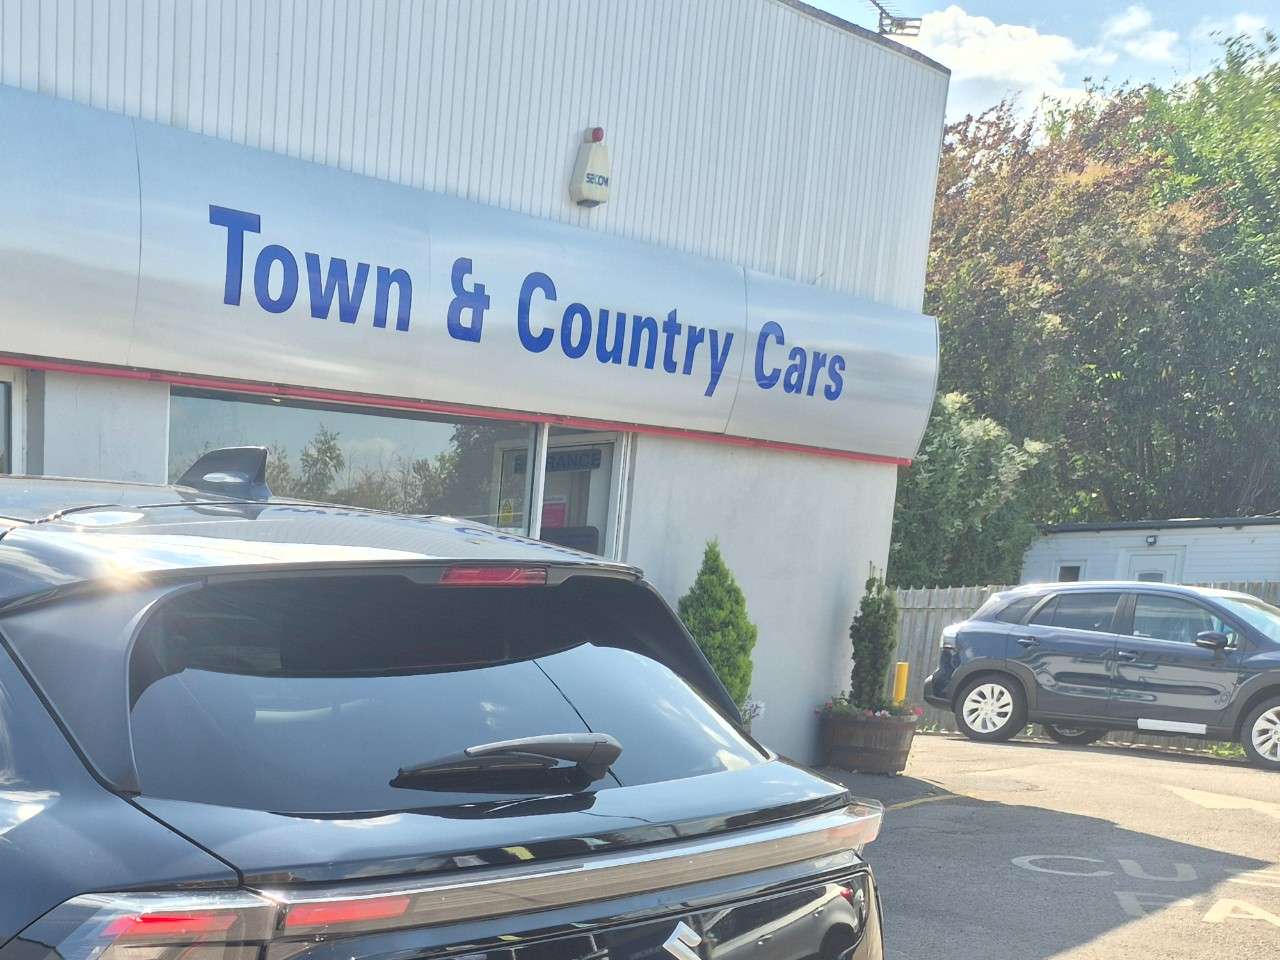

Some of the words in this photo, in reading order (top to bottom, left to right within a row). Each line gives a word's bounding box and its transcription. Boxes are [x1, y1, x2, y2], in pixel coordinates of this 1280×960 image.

[209, 204, 413, 332] Town
[447, 256, 490, 343] &
[517, 271, 734, 397] Country
[754, 320, 846, 401] Cars
